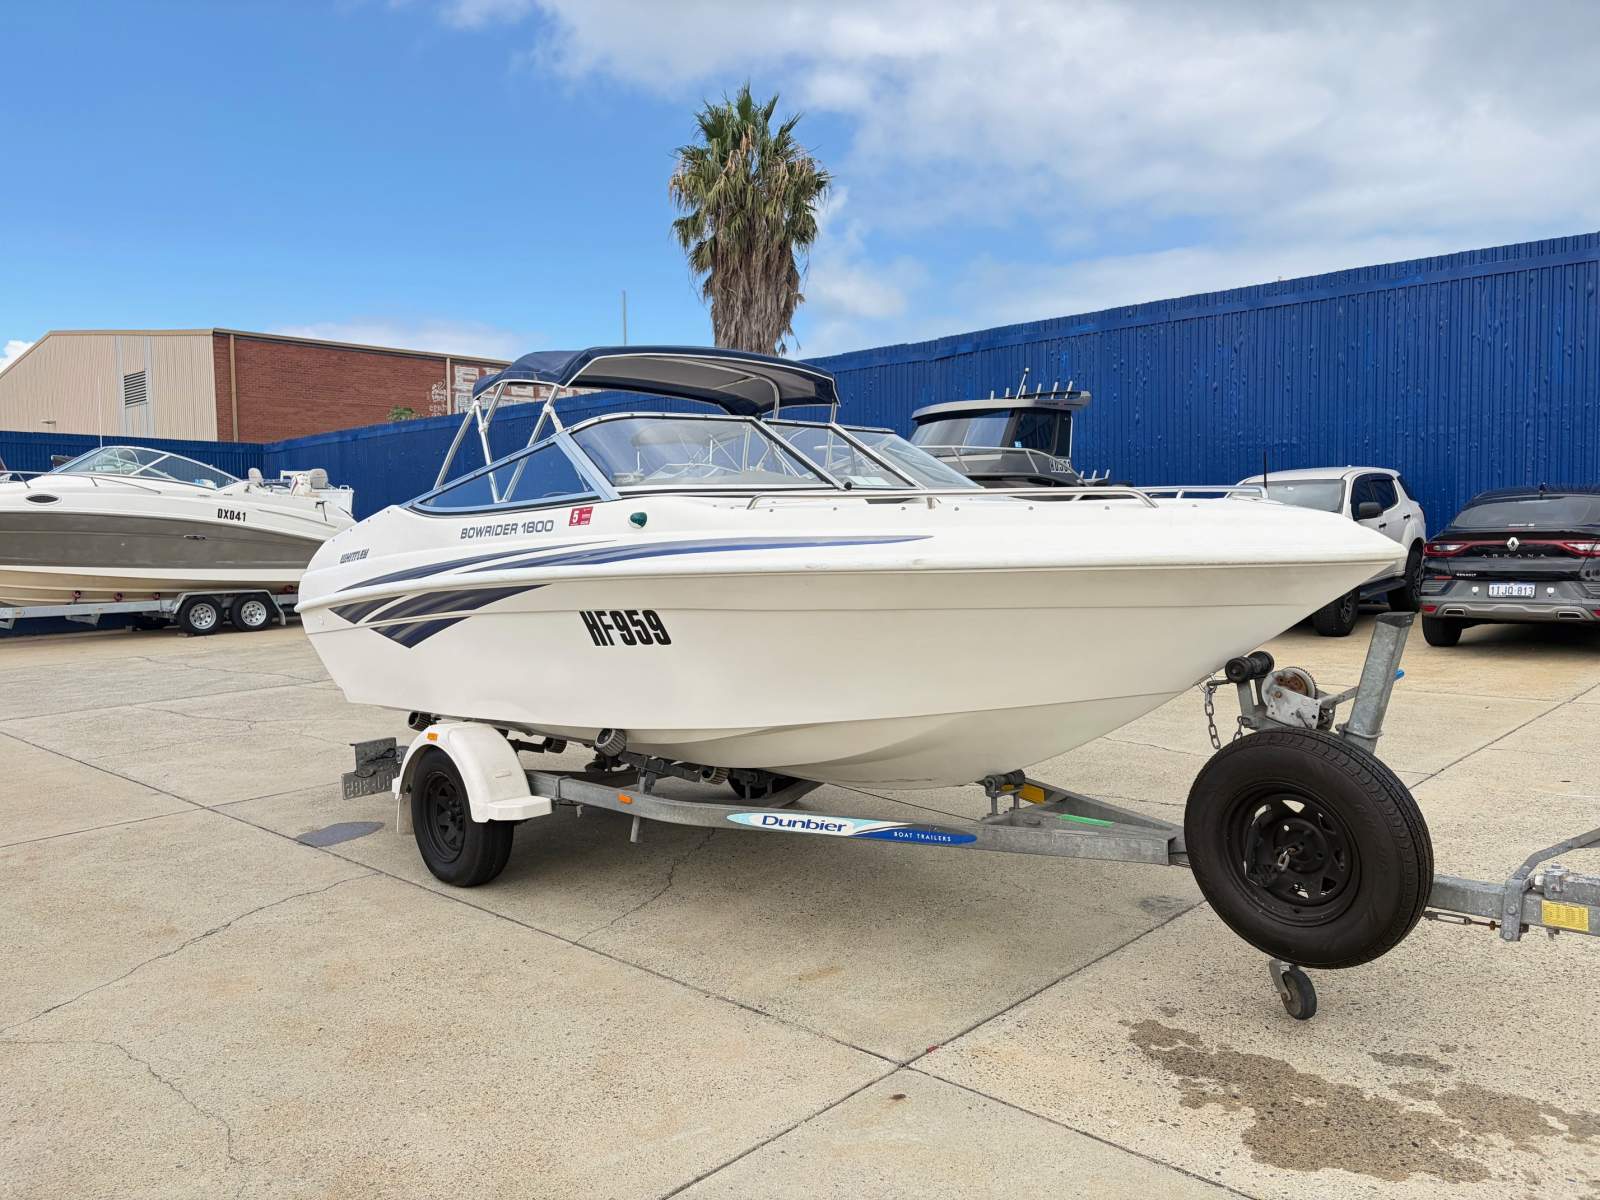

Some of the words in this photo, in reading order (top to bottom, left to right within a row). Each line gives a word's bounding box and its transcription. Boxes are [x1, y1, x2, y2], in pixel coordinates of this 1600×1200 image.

[217, 508, 246, 522] DX041
[572, 510, 580, 523] 5
[460, 523, 519, 540] BOWRIDER
[579, 609, 672, 646] HF959
[762, 815, 847, 832] Dunbier
[916, 833, 951, 842] TRAILERS
